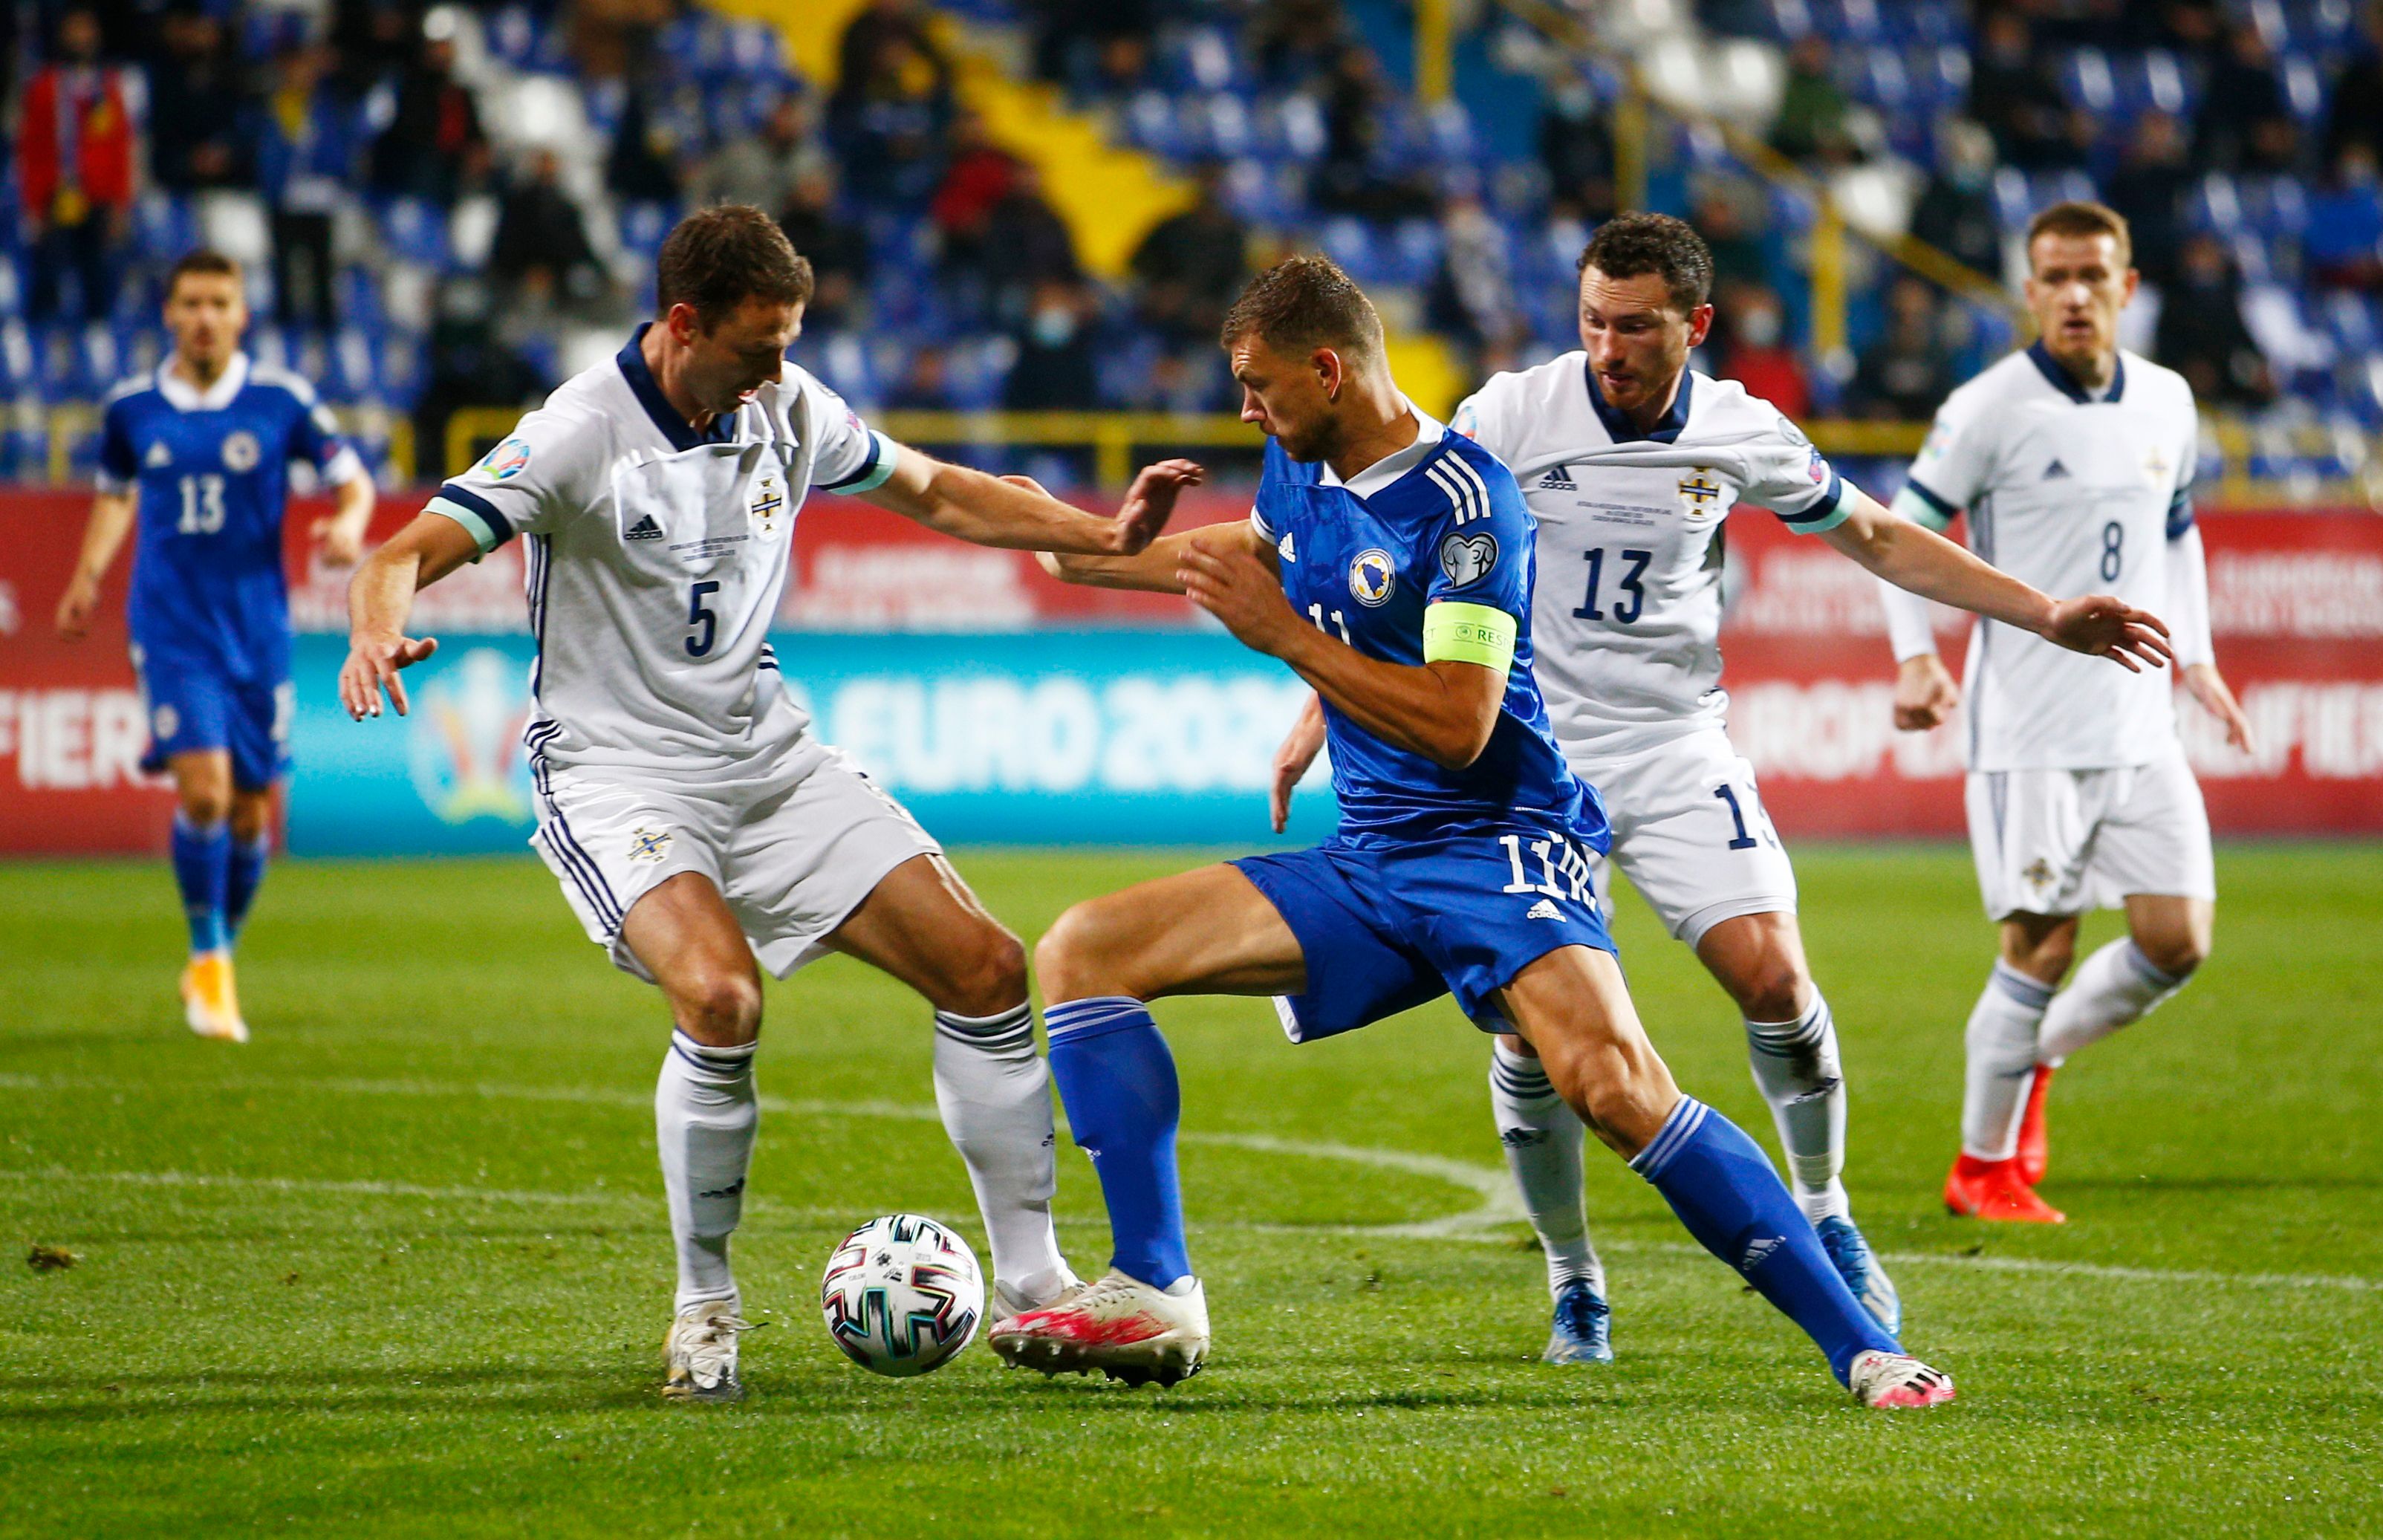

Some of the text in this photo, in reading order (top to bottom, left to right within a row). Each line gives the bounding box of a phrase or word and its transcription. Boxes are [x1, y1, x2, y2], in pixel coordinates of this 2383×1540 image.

[177, 474, 225, 533] 13
[1573, 548, 1651, 623] 13
[2101, 520, 2123, 582] 8
[684, 581, 719, 657] 5
[835, 677, 1096, 790] EURO
[1499, 834, 1567, 901] 11
